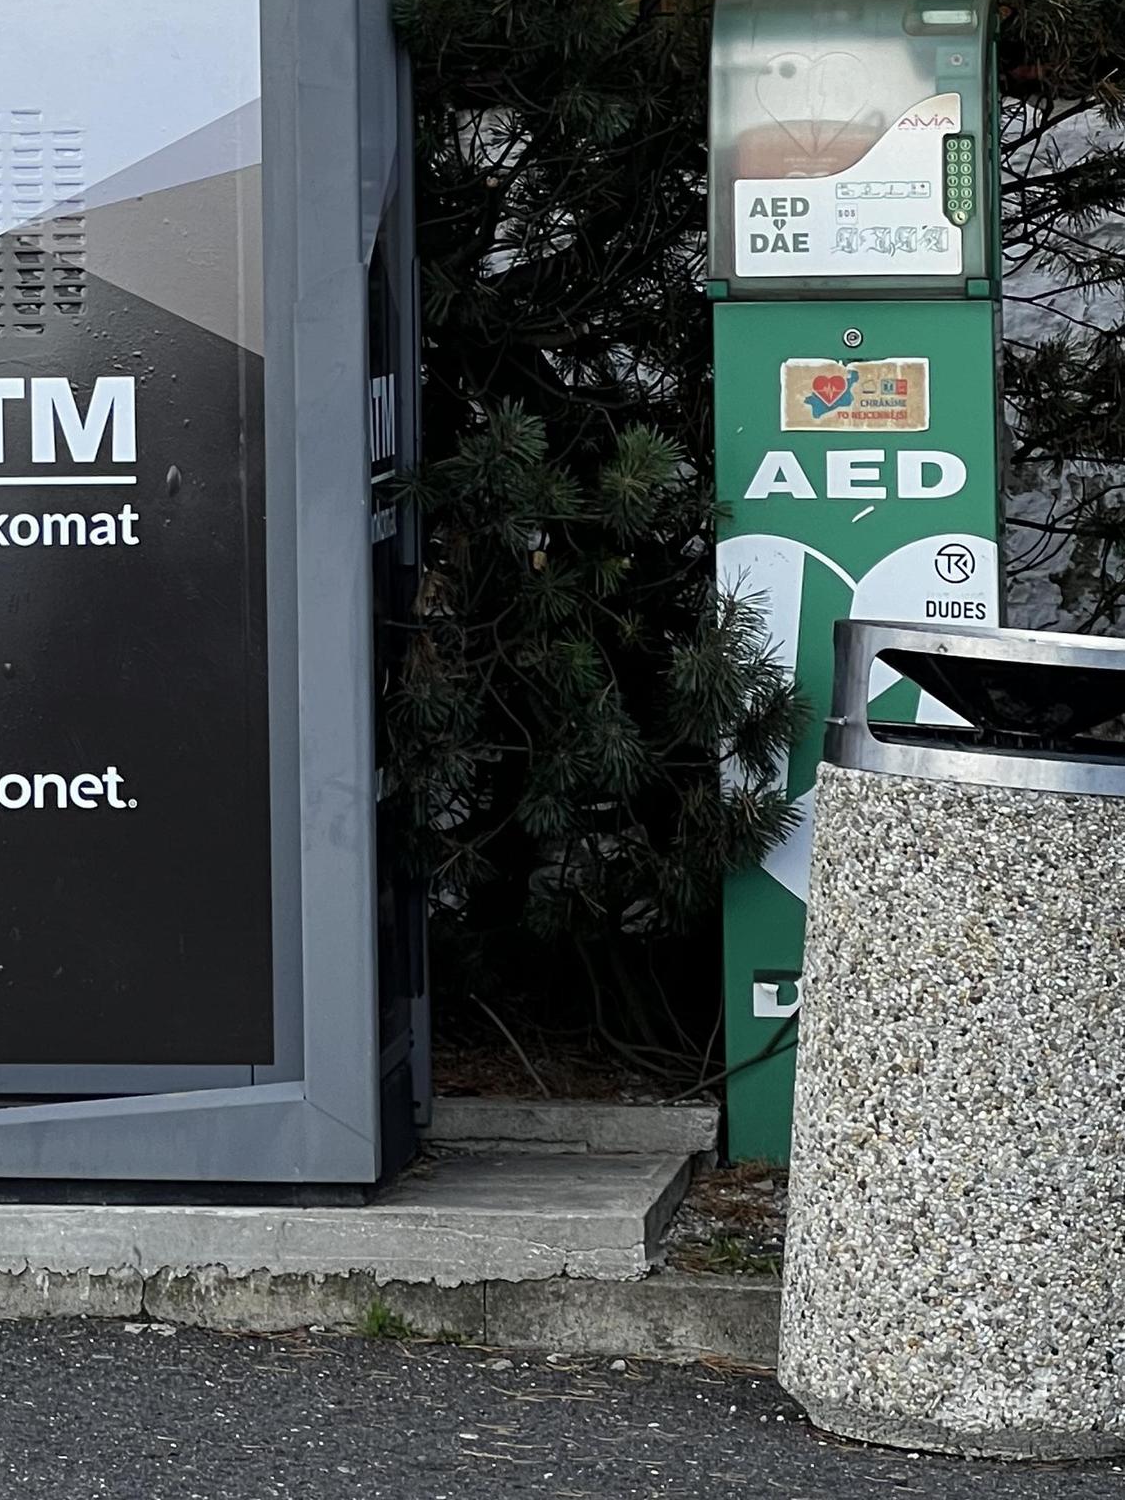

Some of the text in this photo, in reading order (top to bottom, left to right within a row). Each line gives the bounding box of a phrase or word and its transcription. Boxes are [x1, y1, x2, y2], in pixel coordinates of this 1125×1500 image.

[749, 197, 810, 218] AED
[838, 209, 856, 218] SOS
[750, 232, 810, 254] DAE
[837, 411, 849, 420] TO
[744, 449, 967, 499] AED
[926, 600, 987, 620] DUDES
